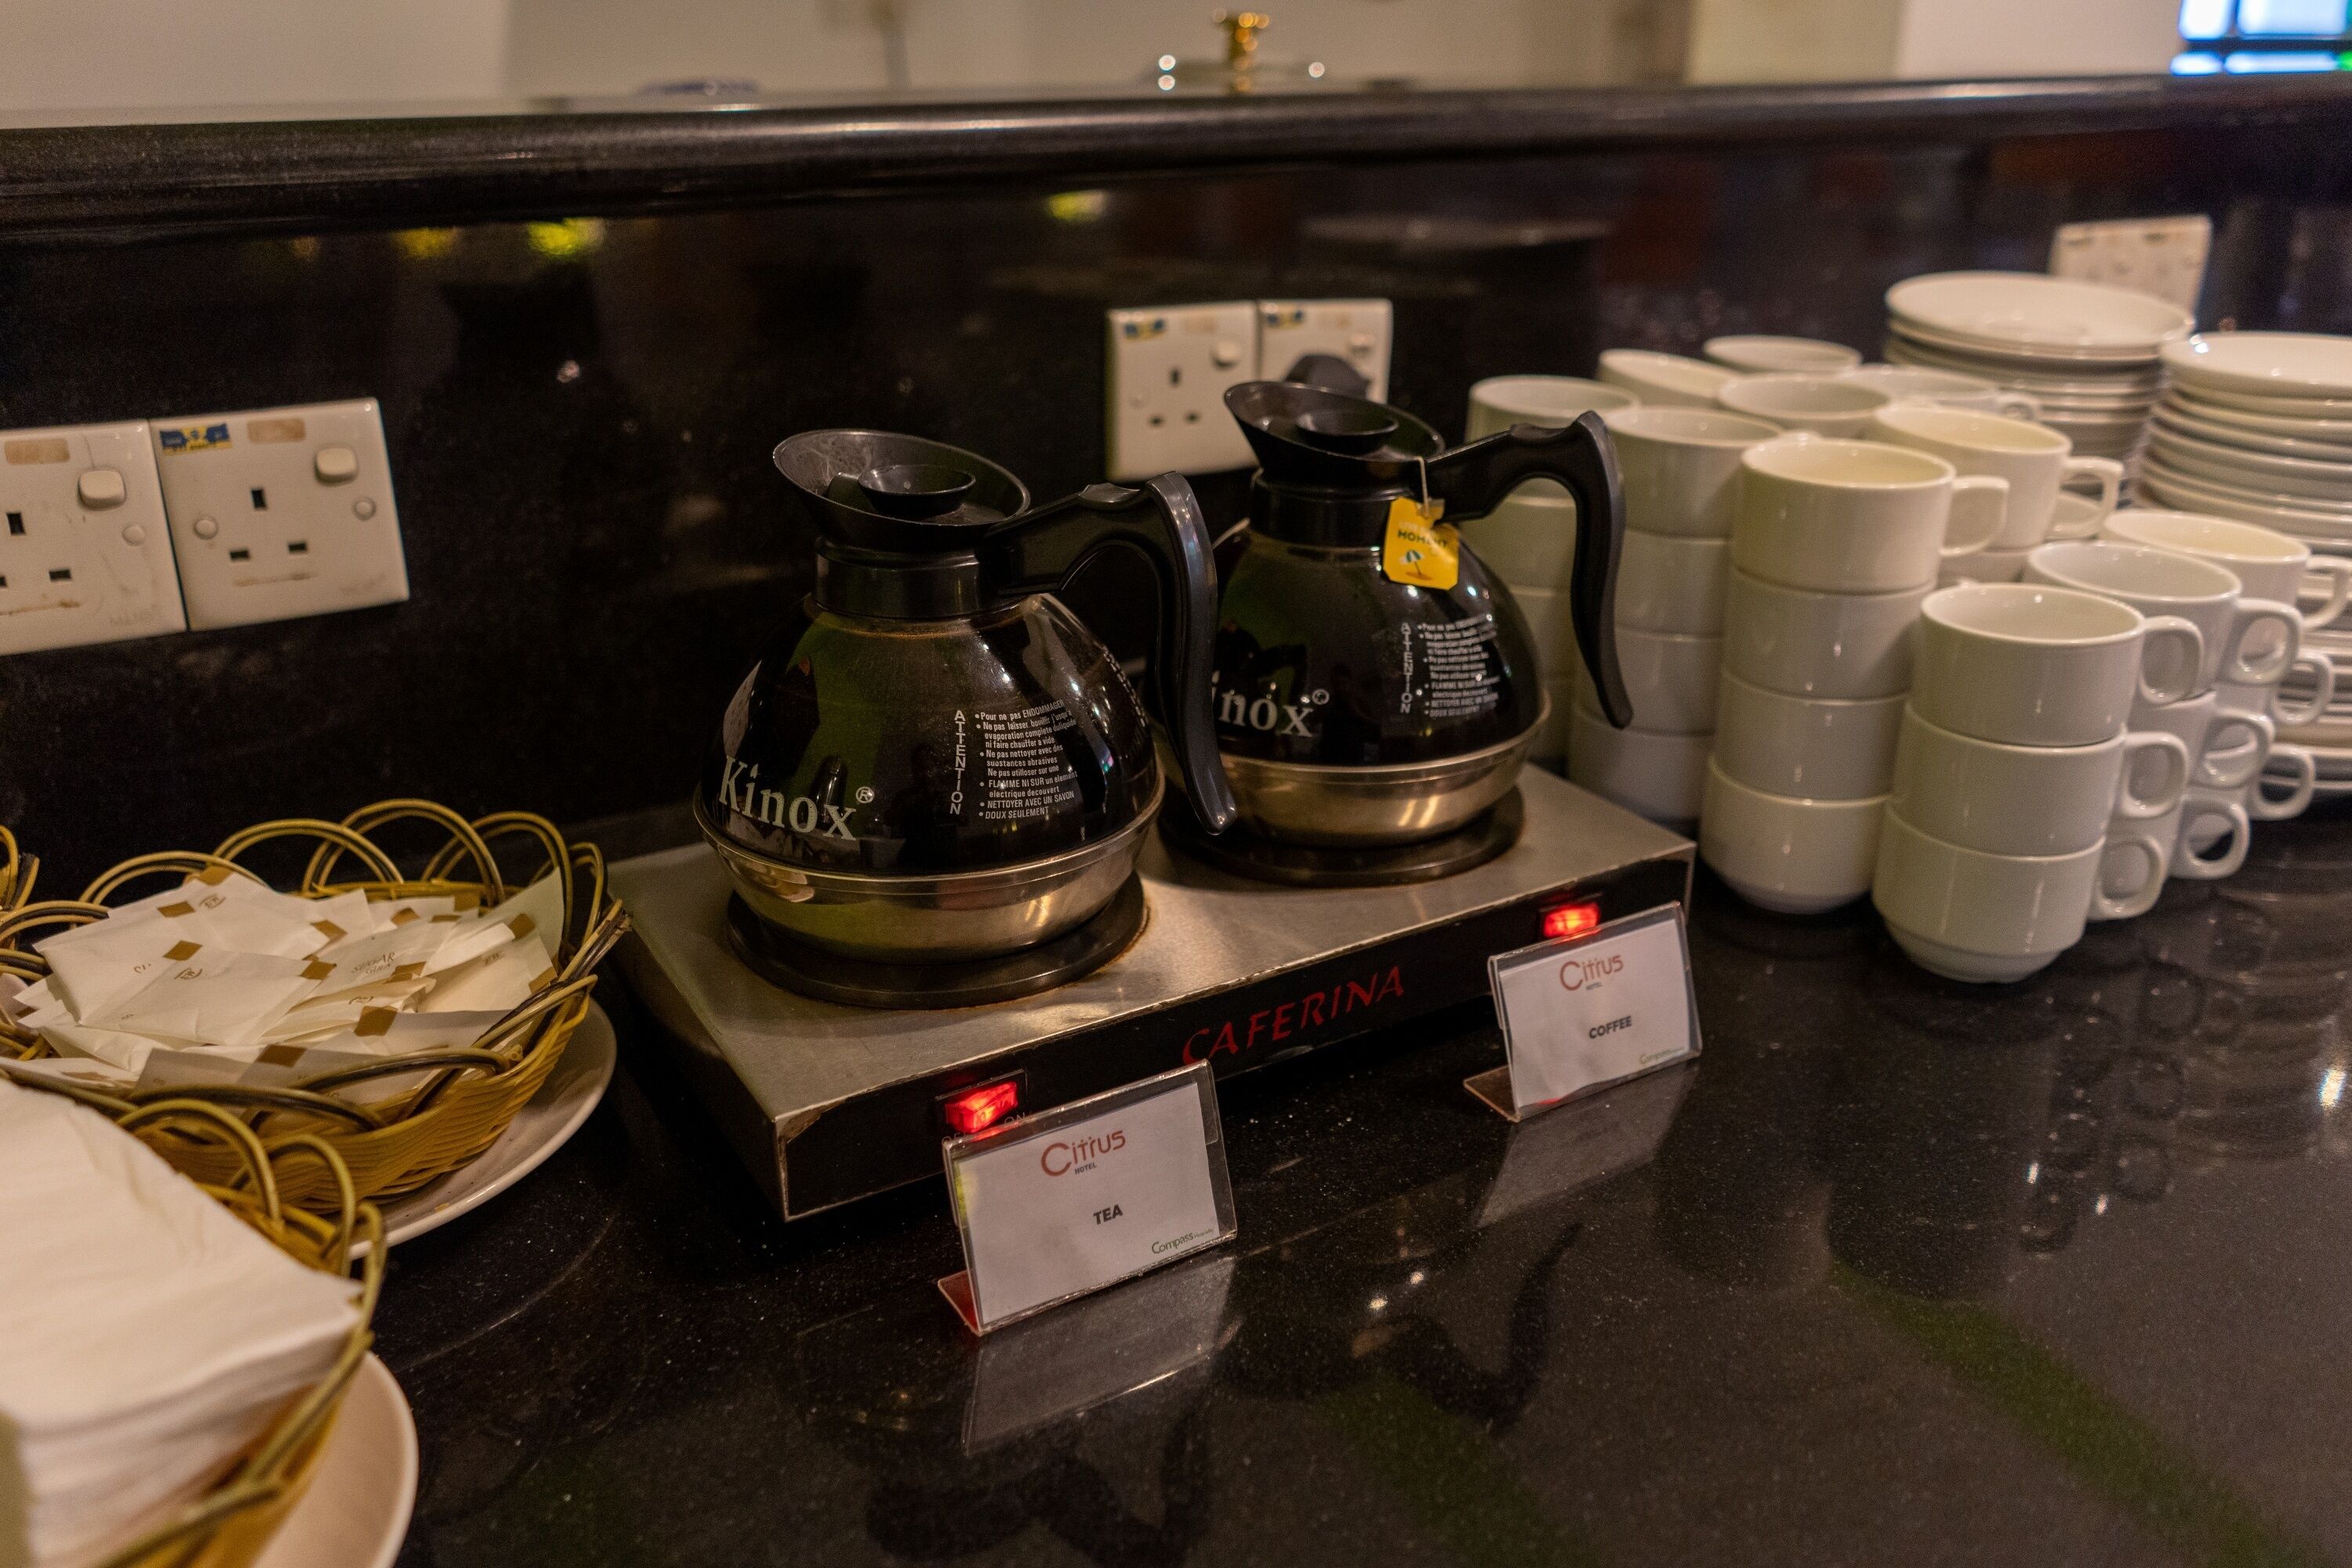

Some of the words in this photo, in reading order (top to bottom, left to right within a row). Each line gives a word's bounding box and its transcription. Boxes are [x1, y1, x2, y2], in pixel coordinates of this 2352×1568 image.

[1400, 622, 1414, 713] ATTENTION
[980, 711, 996, 720] Pour
[1010, 712, 1022, 721] pas
[1022, 699, 1065, 718] ENDOMMAGER
[982, 721, 993, 730] Ne
[993, 724, 1005, 732] pas
[1007, 721, 1028, 731] laisser
[985, 731, 1024, 741] evaporation
[1025, 727, 1053, 737] complete
[986, 750, 996, 758] Ne
[1010, 749, 1037, 758] nettoyer
[1053, 744, 1064, 753] des
[993, 740, 1009, 749] faire
[1010, 739, 1036, 748] chauffer
[1043, 735, 1055, 745] vide
[949, 710, 966, 815] ATTENTION
[1028, 757, 1058, 766] abrasives
[989, 779, 1020, 789] FLAMME
[1030, 778, 1044, 786] SUR
[1054, 771, 1078, 783] element
[998, 770, 1011, 779] pas
[987, 800, 1023, 809] NETTOYER
[1025, 797, 1042, 808] AVEC
[1043, 796, 1052, 804] UN
[1054, 790, 1075, 803] SAVON
[989, 789, 1025, 799] electrique
[1027, 786, 1060, 797] decouvert
[985, 811, 1007, 819] DOUX
[1007, 806, 1049, 818] SEULEMENT
[1559, 955, 1624, 992] Citrus
[1182, 966, 1405, 1065] CAFERINA
[1588, 1015, 1632, 1039] COFFEE
[1041, 1130, 1126, 1177] Citrus
[1074, 1162, 1098, 1174] HOTEL
[1093, 1204, 1123, 1225] TEA
[1152, 1232, 1194, 1254] Compass
